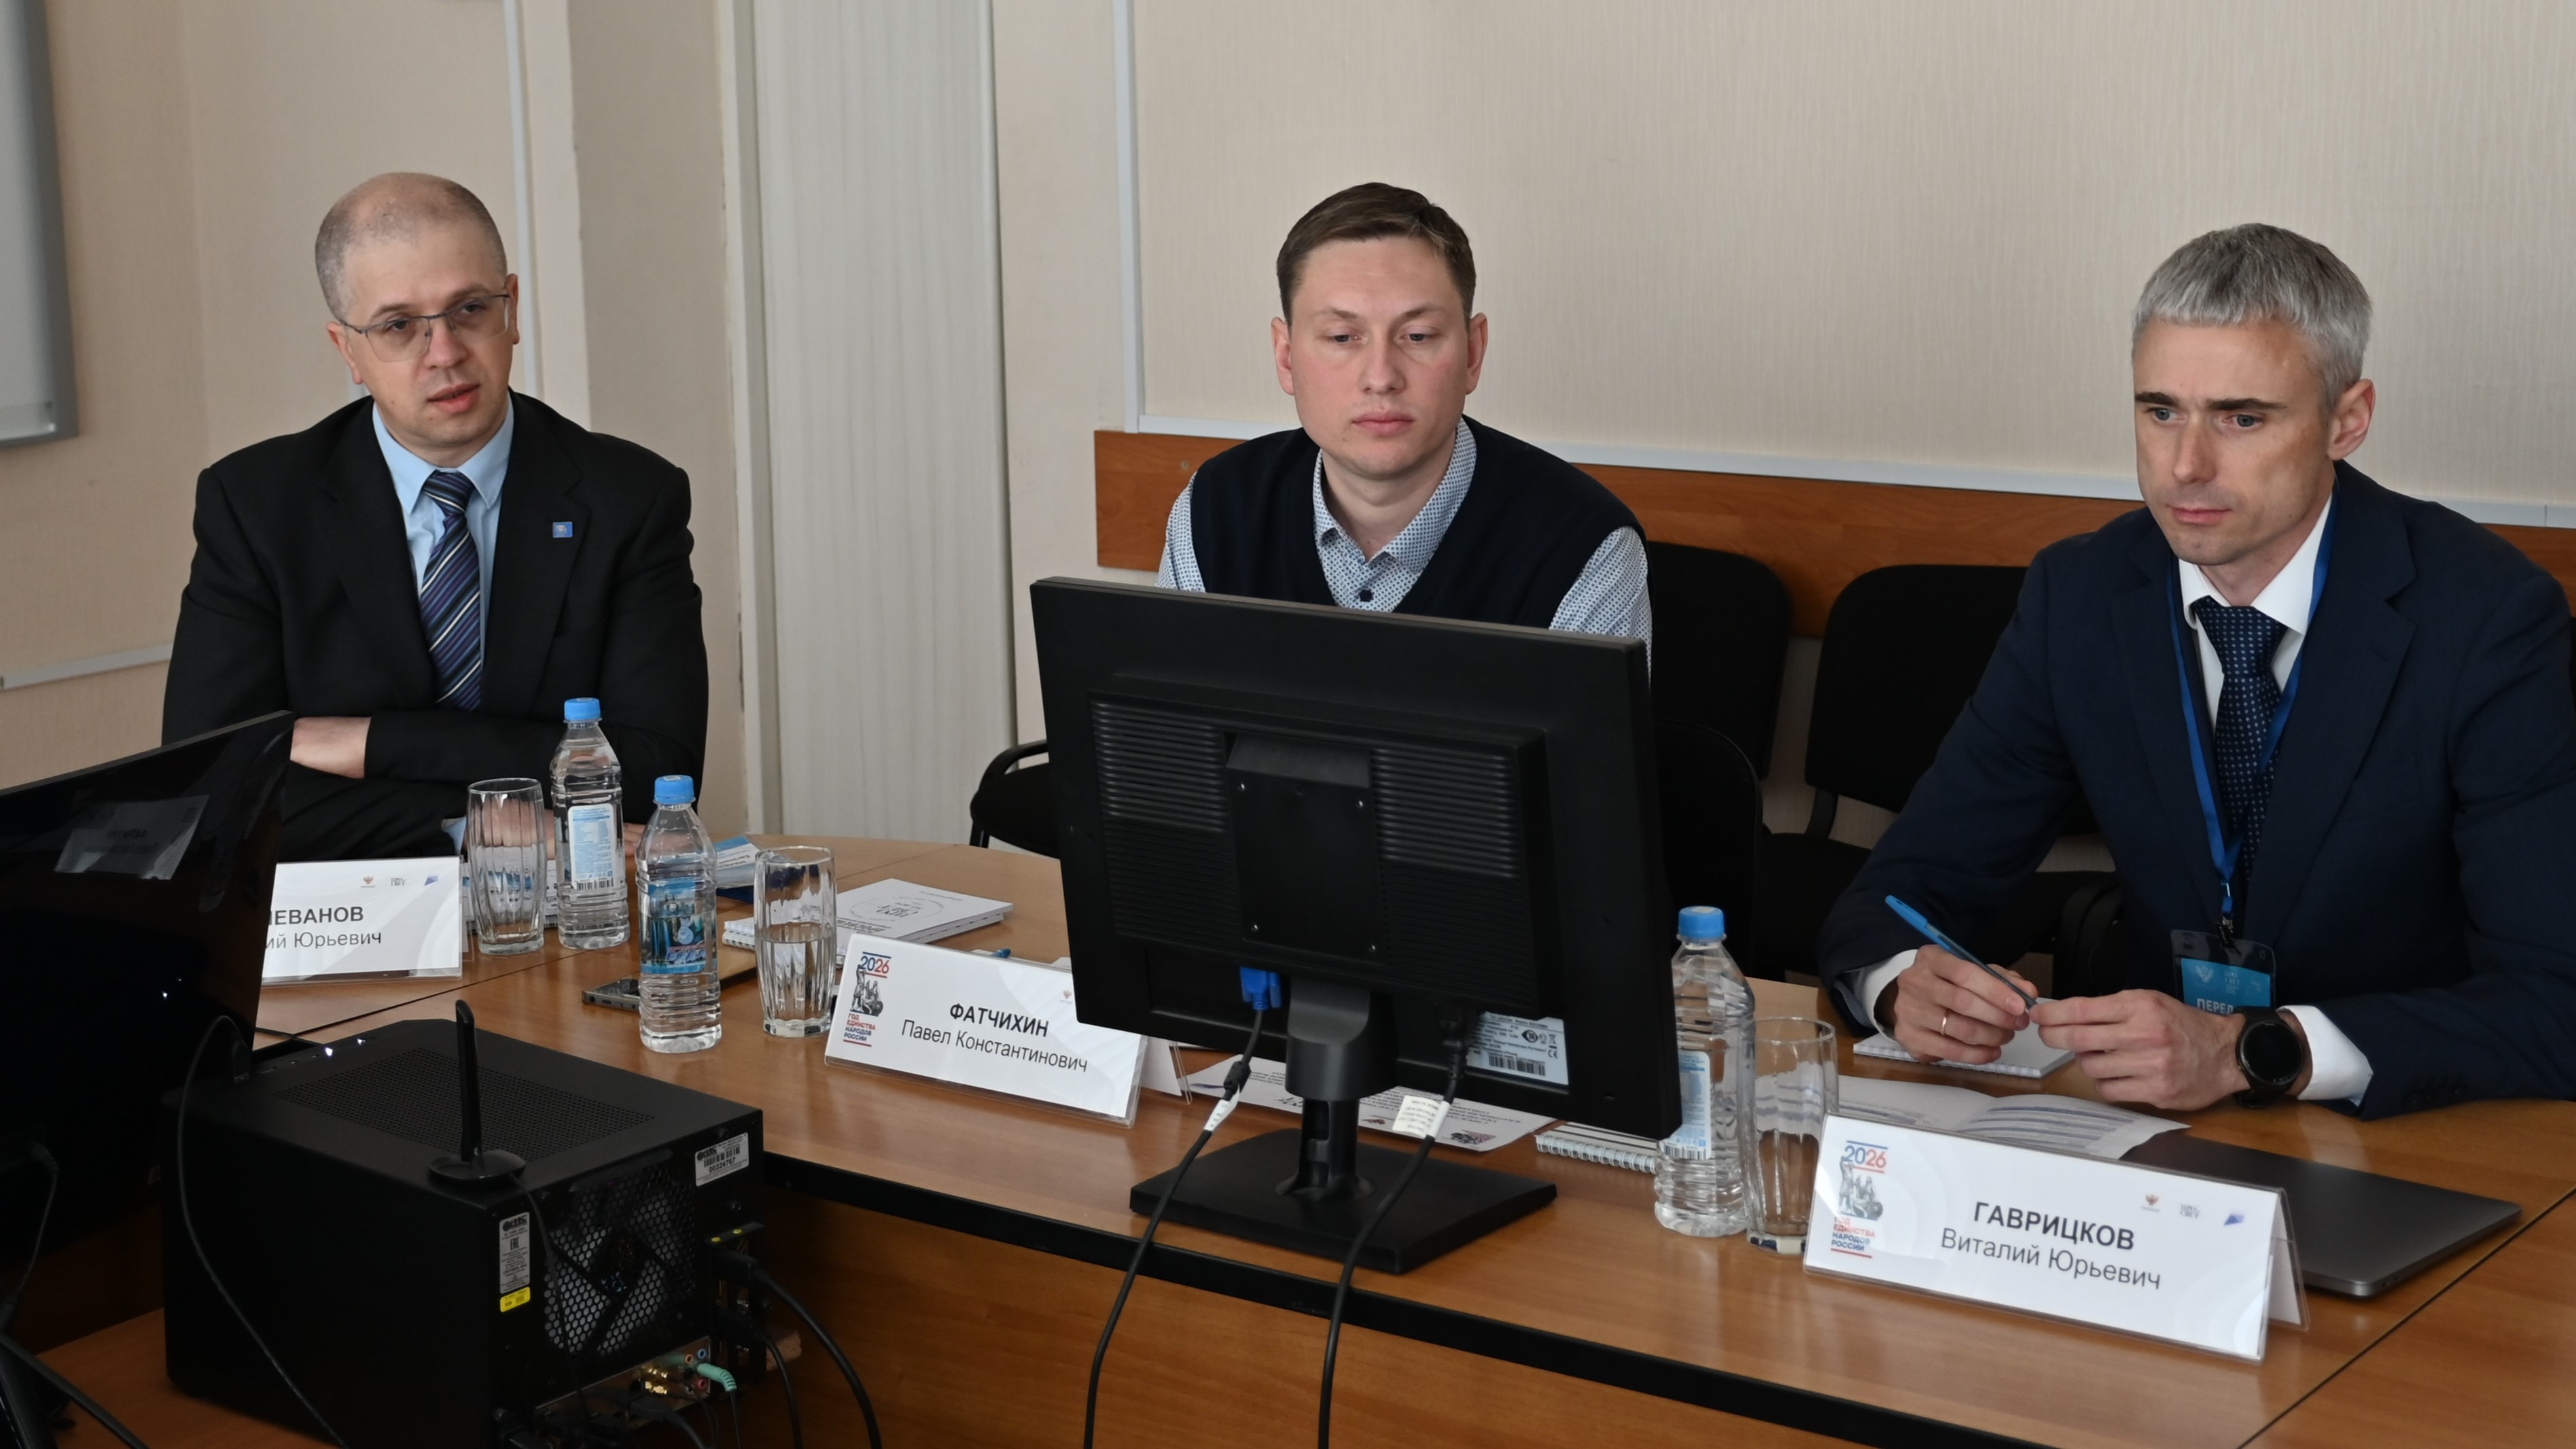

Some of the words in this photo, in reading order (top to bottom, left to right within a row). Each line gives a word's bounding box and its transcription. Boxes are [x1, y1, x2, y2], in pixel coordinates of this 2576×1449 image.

[268, 906, 364, 926] ЕВАНОВ
[266, 934, 287, 949] ий
[294, 932, 382, 949] Юрьевич
[860, 956, 889, 974] 2026
[847, 1019, 875, 1030] ЕДИНСТВА
[950, 1003, 1049, 1037] ФАТЧИХИН
[844, 1032, 867, 1041] РОССИИ
[845, 1026, 872, 1036] НАРОДОВ
[902, 1019, 951, 1045] Павел
[955, 1030, 1088, 1072] Константинович
[1844, 1145, 1886, 1168] 2026
[1833, 1223, 1875, 1238] ЕДИНСТВА
[1973, 1202, 2135, 1251] ГАВРИЦКОВ
[1831, 1240, 1865, 1252] РОССИИ
[1832, 1232, 1870, 1245] НАРОДОВ
[1941, 1227, 2041, 1265] Виталий
[2048, 1248, 2161, 1290] Юрьевич
